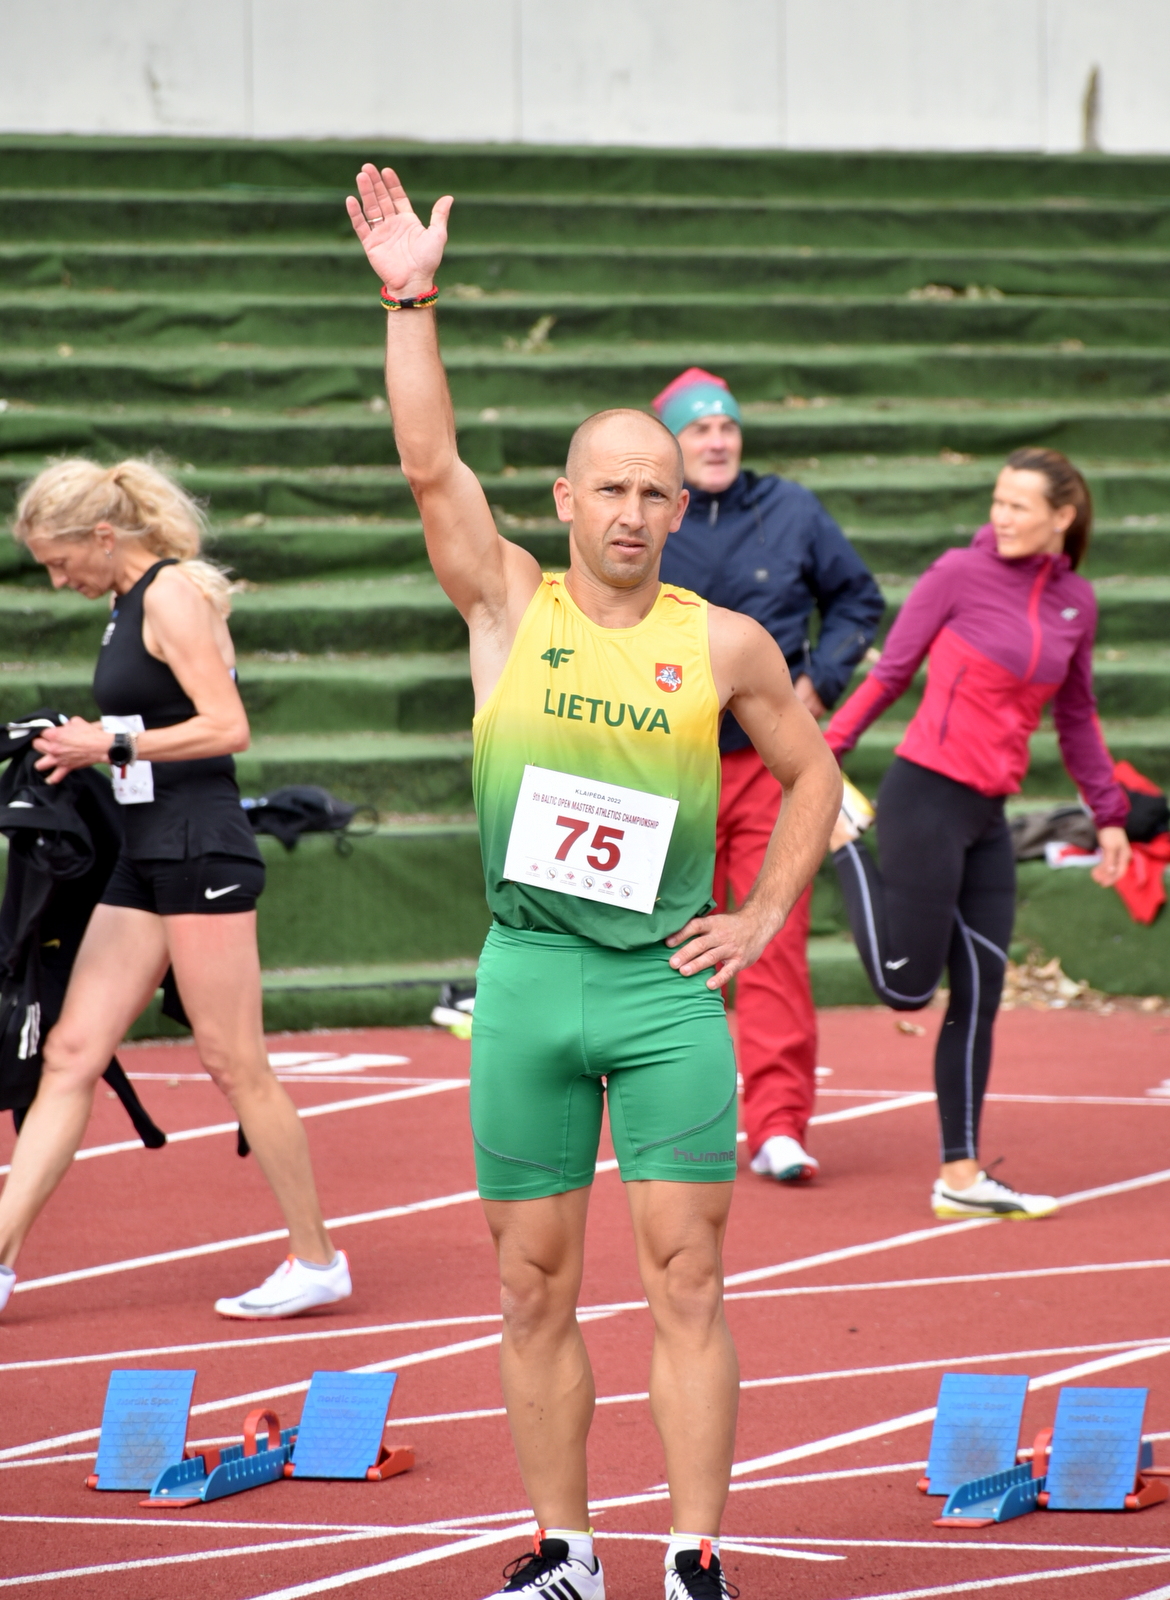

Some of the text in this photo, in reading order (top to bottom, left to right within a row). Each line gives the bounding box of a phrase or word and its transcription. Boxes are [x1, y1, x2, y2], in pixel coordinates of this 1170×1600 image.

[540, 647, 575, 669] 4F
[543, 688, 671, 734] LIETUVA
[541, 793, 557, 806] BALTIC
[557, 797, 571, 809] OPEN
[571, 801, 595, 815] MASTERS
[595, 807, 622, 821] ATHLETICS
[622, 813, 659, 829] CHAMPIONSHIP
[607, 796, 622, 805] 2022
[555, 815, 625, 872] 75
